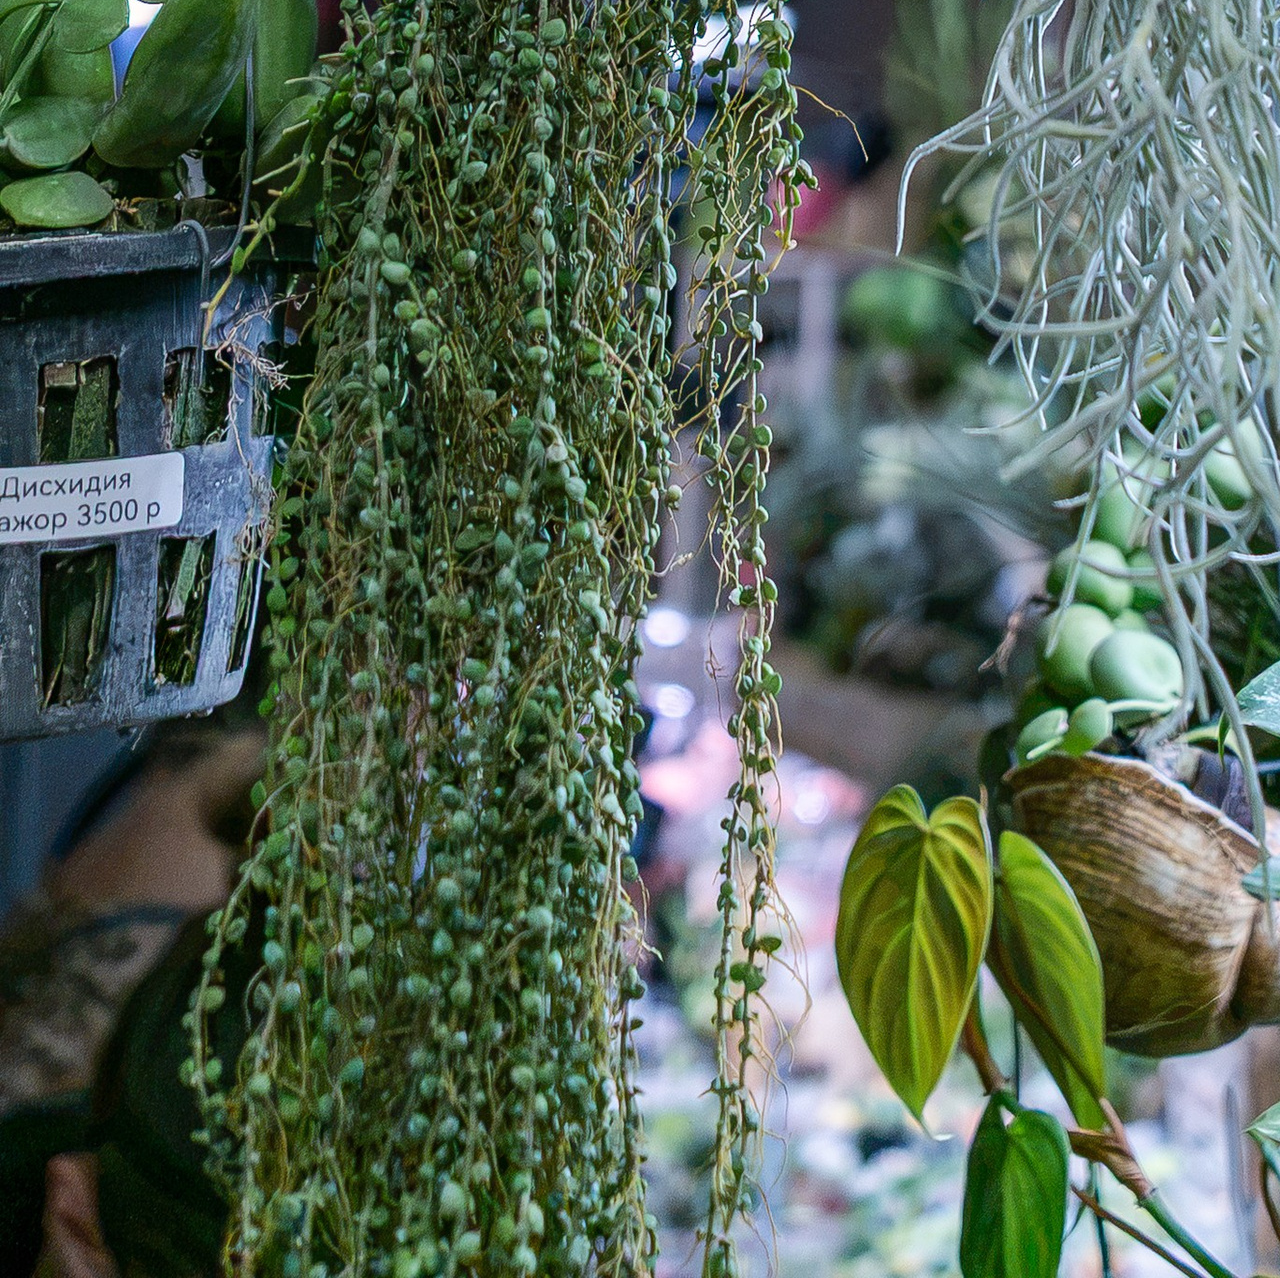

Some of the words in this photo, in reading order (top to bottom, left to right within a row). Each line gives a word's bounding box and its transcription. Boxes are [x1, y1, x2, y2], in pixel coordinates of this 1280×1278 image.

[0, 472, 131, 502] Дисхидия
[0, 511, 67, 535] ажор
[77, 498, 139, 526] 3500
[146, 501, 161, 524] р
